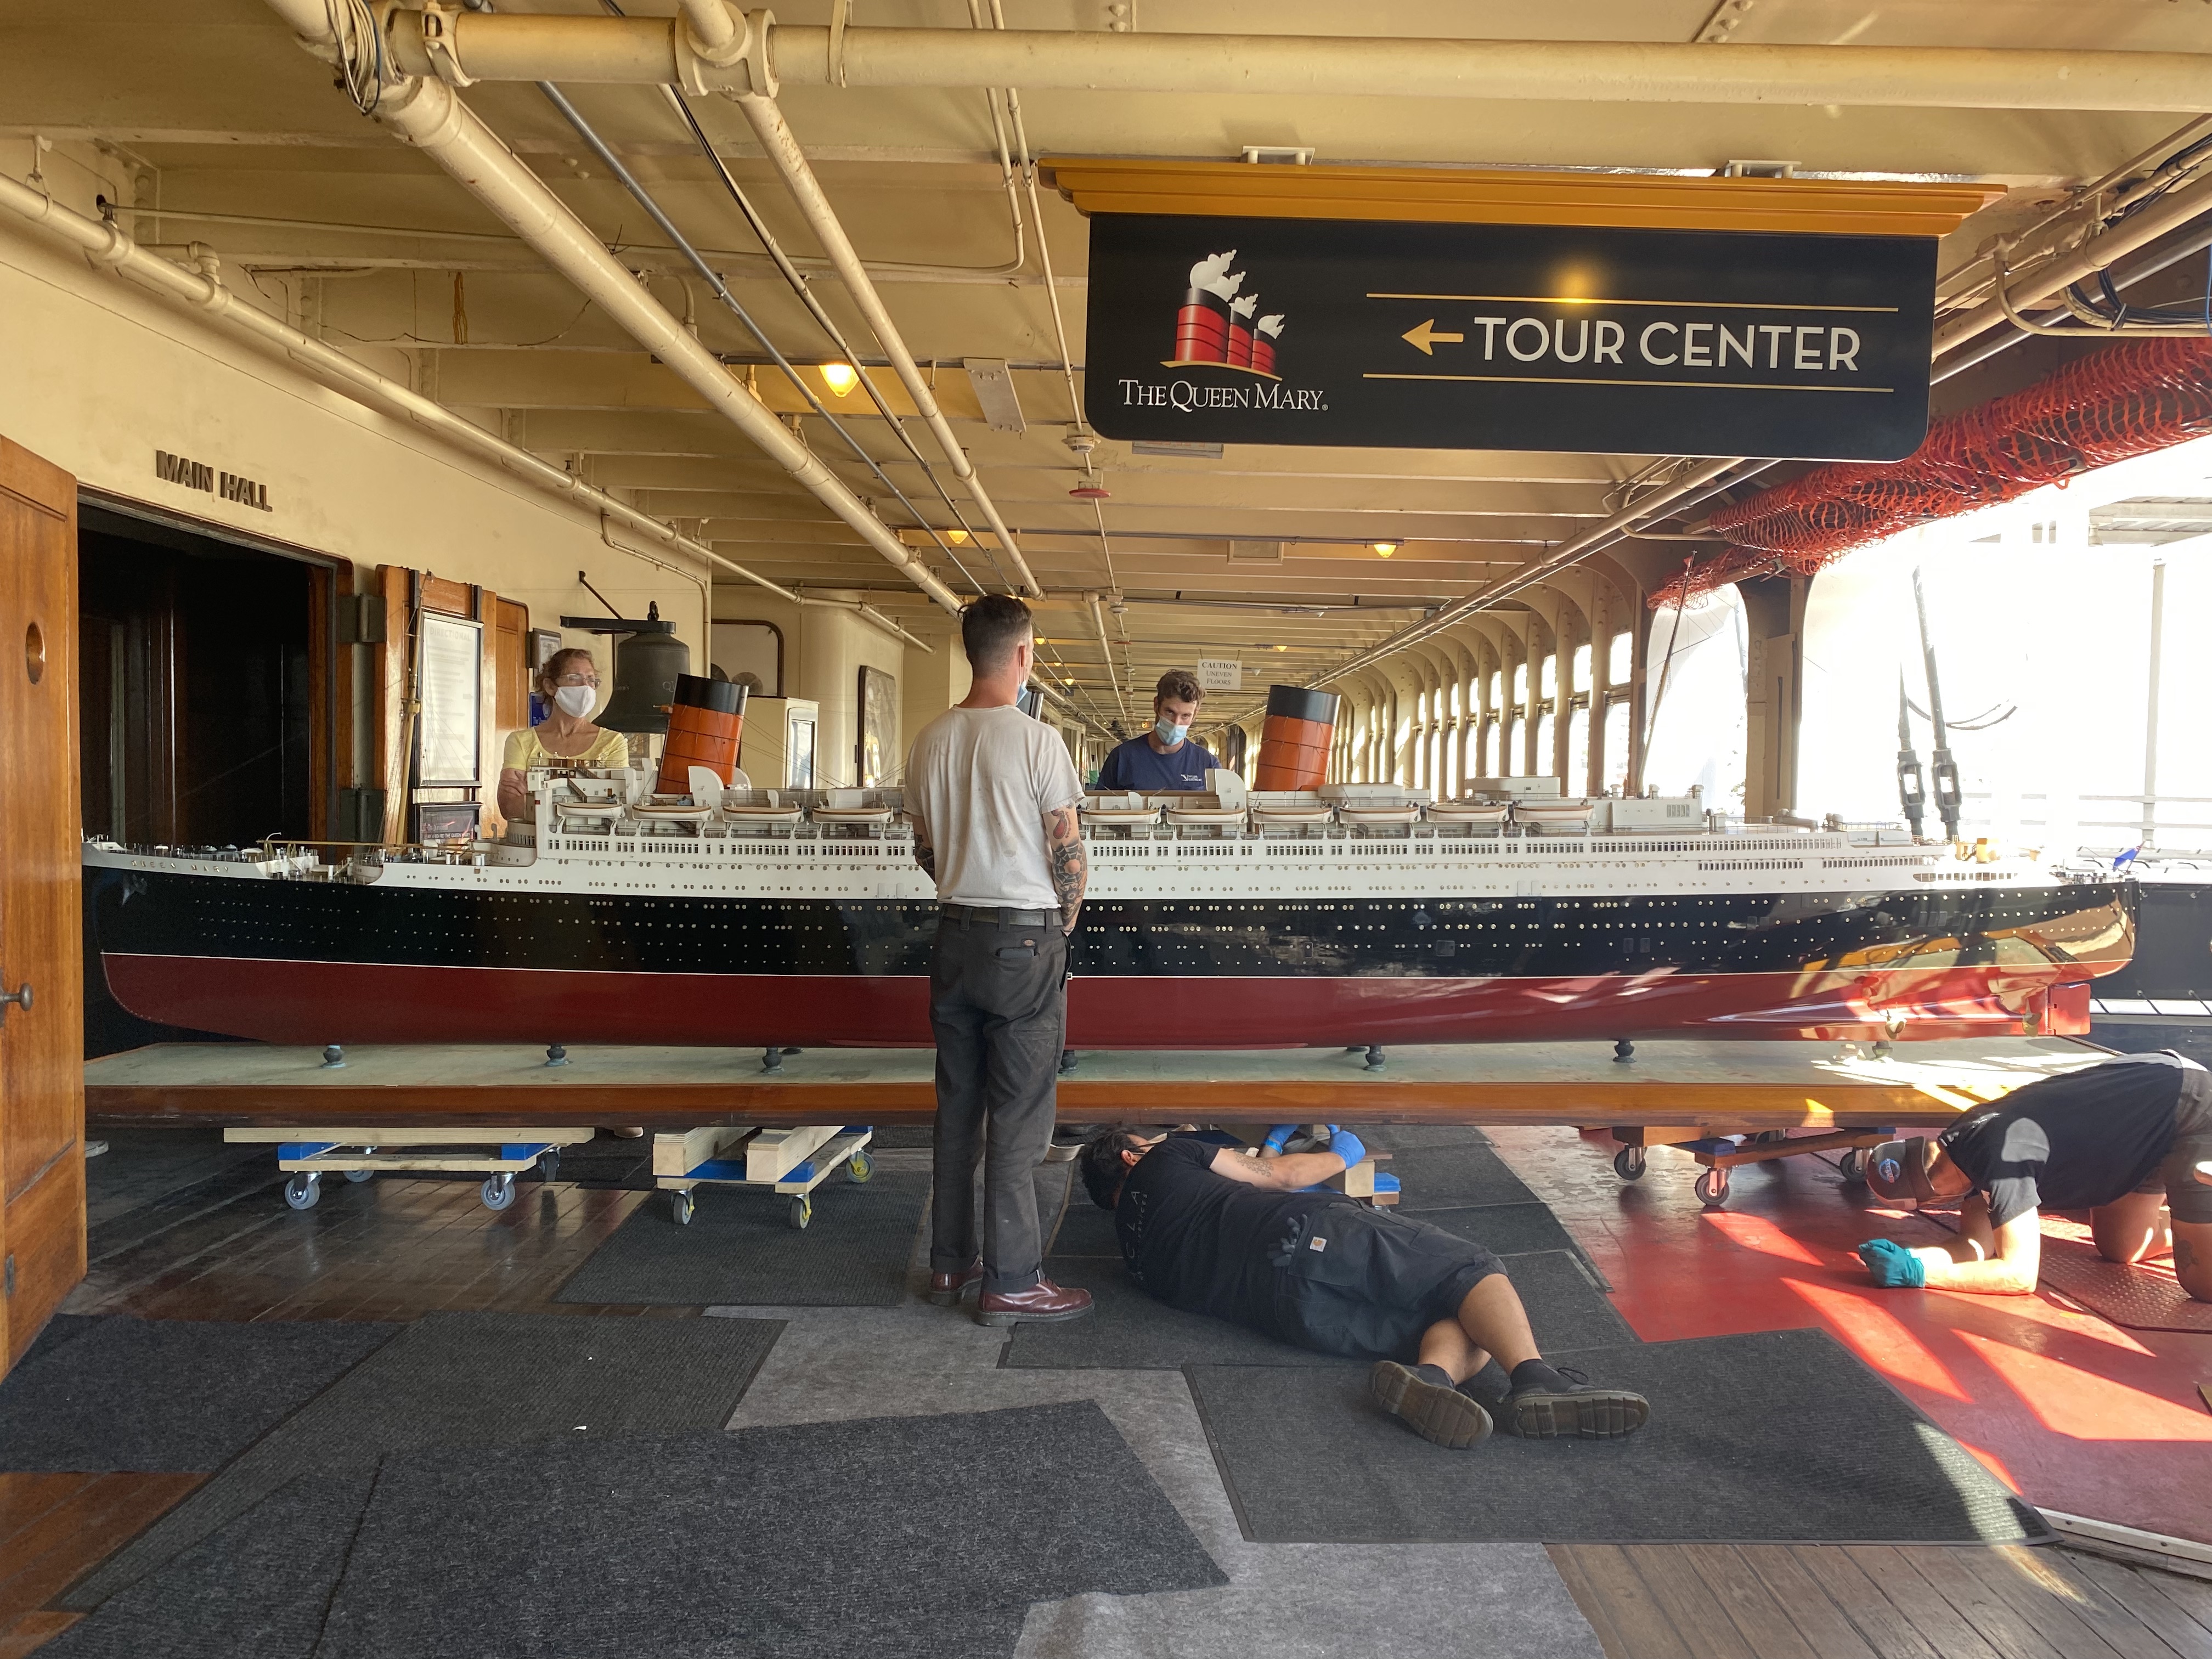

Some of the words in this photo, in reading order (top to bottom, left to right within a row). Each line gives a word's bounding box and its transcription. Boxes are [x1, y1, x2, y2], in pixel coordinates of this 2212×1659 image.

[1474, 317, 1625, 364] TOUR
[1640, 321, 1860, 371] CENTER
[1118, 379, 1167, 407] THE
[1170, 380, 1250, 413] QUEEN
[156, 450, 213, 493] MAIN
[220, 471, 273, 512] HALL
[430, 627, 471, 641] DIRECTIONAL
[131, 860, 176, 869] QUEEN
[191, 864, 229, 873] MARY
